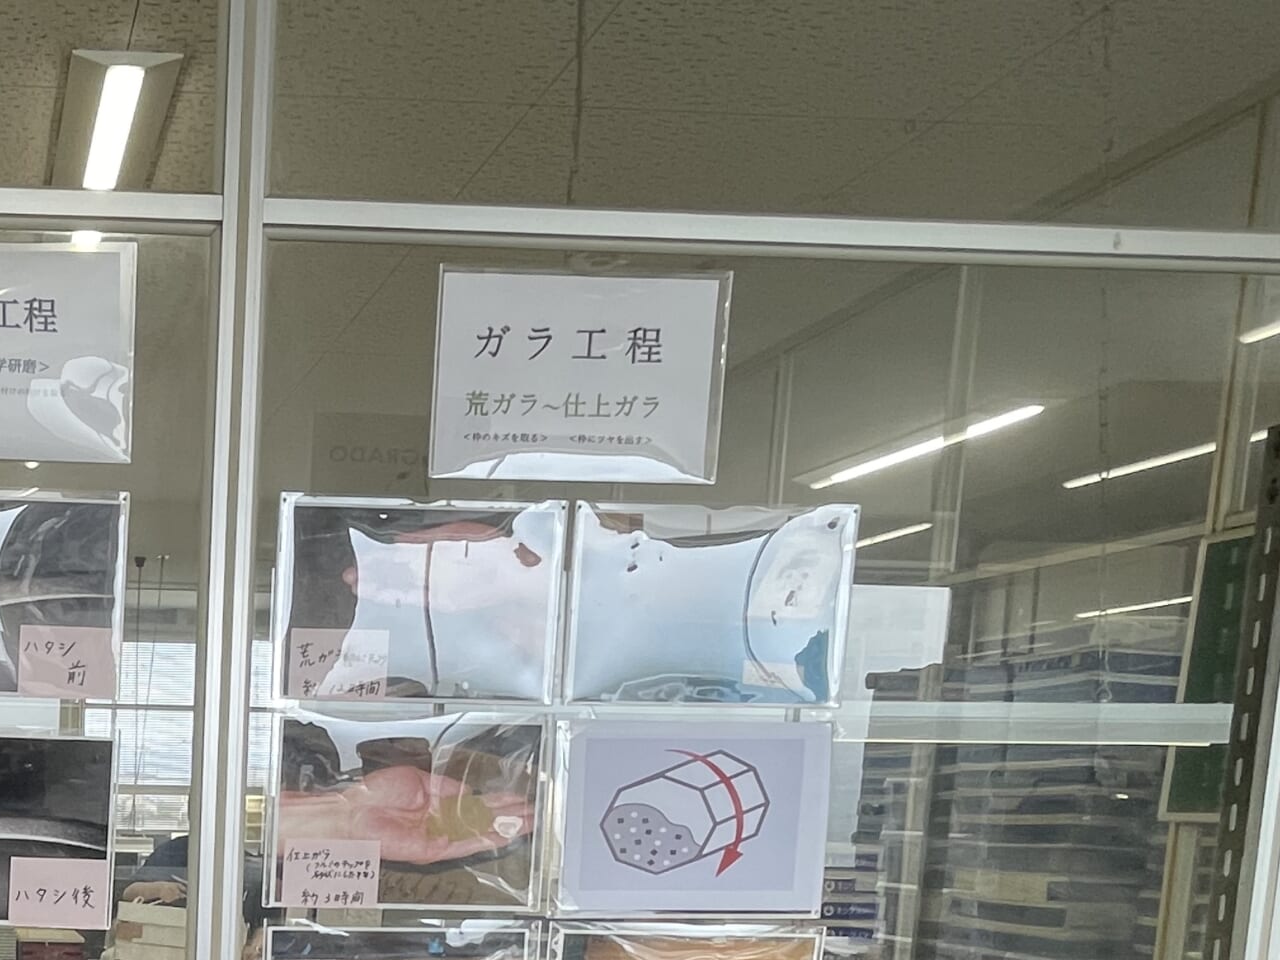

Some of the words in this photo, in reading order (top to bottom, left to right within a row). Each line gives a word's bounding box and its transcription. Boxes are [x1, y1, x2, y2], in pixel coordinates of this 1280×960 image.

[474, 325, 662, 364] ガラ工程
[24, 641, 76, 657] ハタシ
[67, 660, 86, 686] 前
[15, 885, 95, 909] ハタシ後
